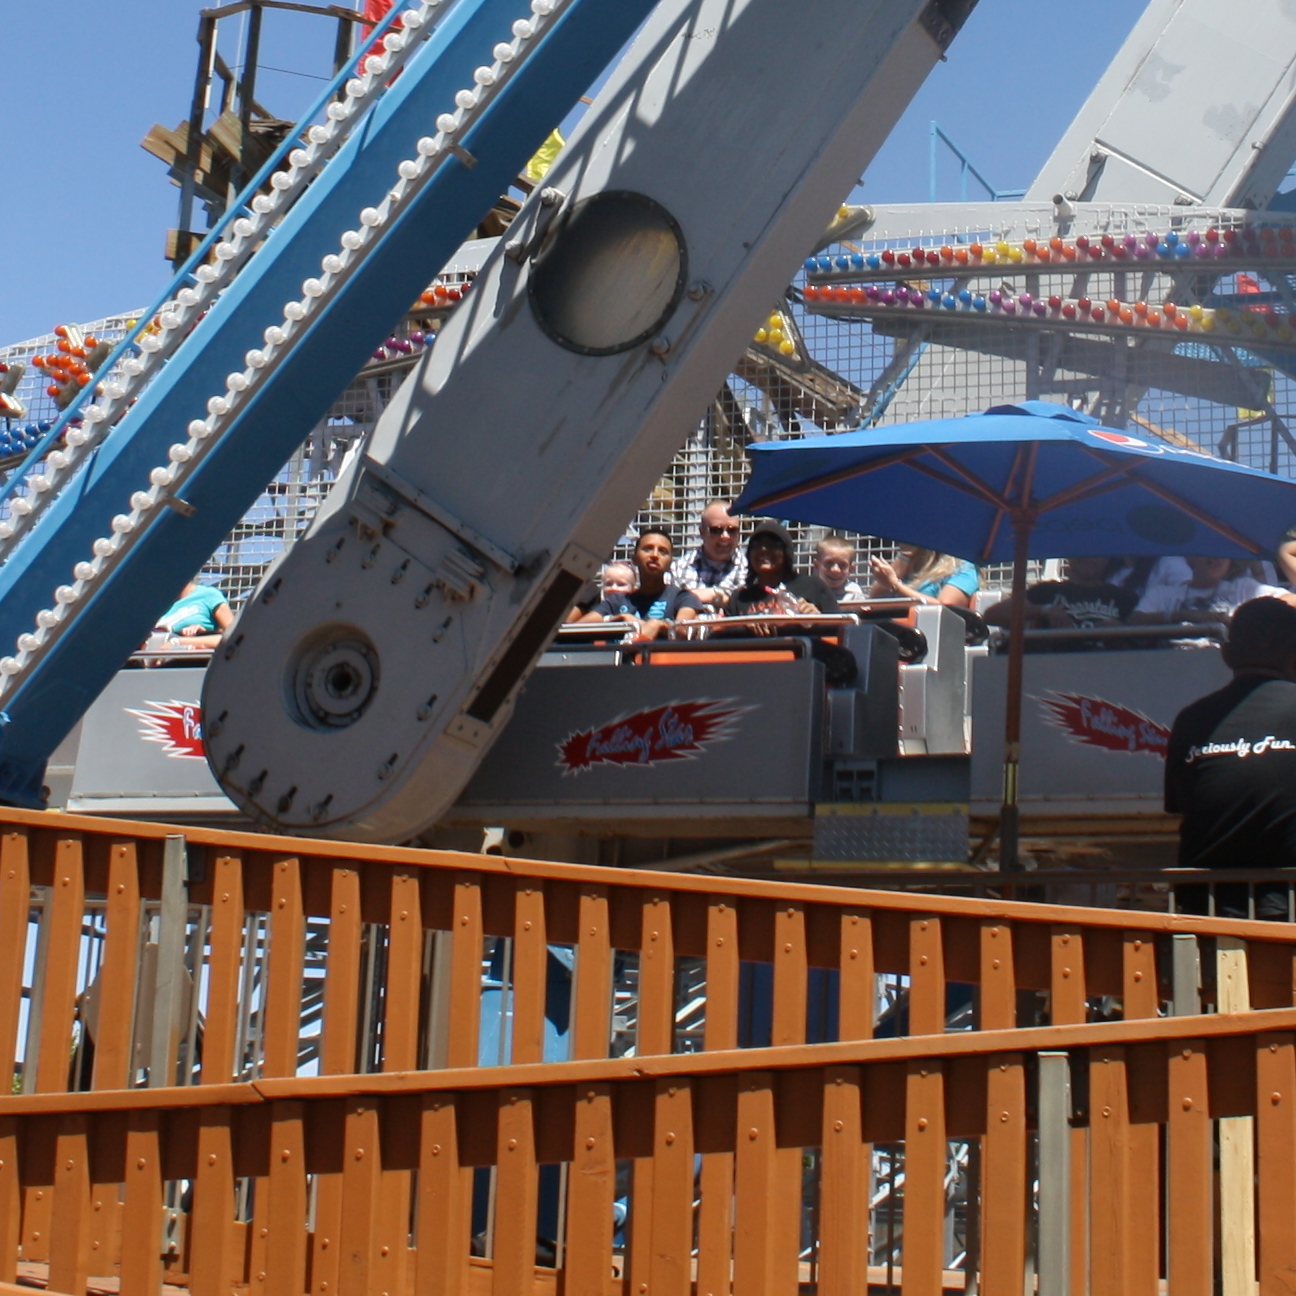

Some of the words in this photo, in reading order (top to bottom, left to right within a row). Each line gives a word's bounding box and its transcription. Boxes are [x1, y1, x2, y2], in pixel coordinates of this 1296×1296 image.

[585, 725, 654, 764] Falling
[655, 706, 693, 750] Star
[1080, 699, 1136, 751] Falling
[1185, 737, 1251, 763] Seriously
